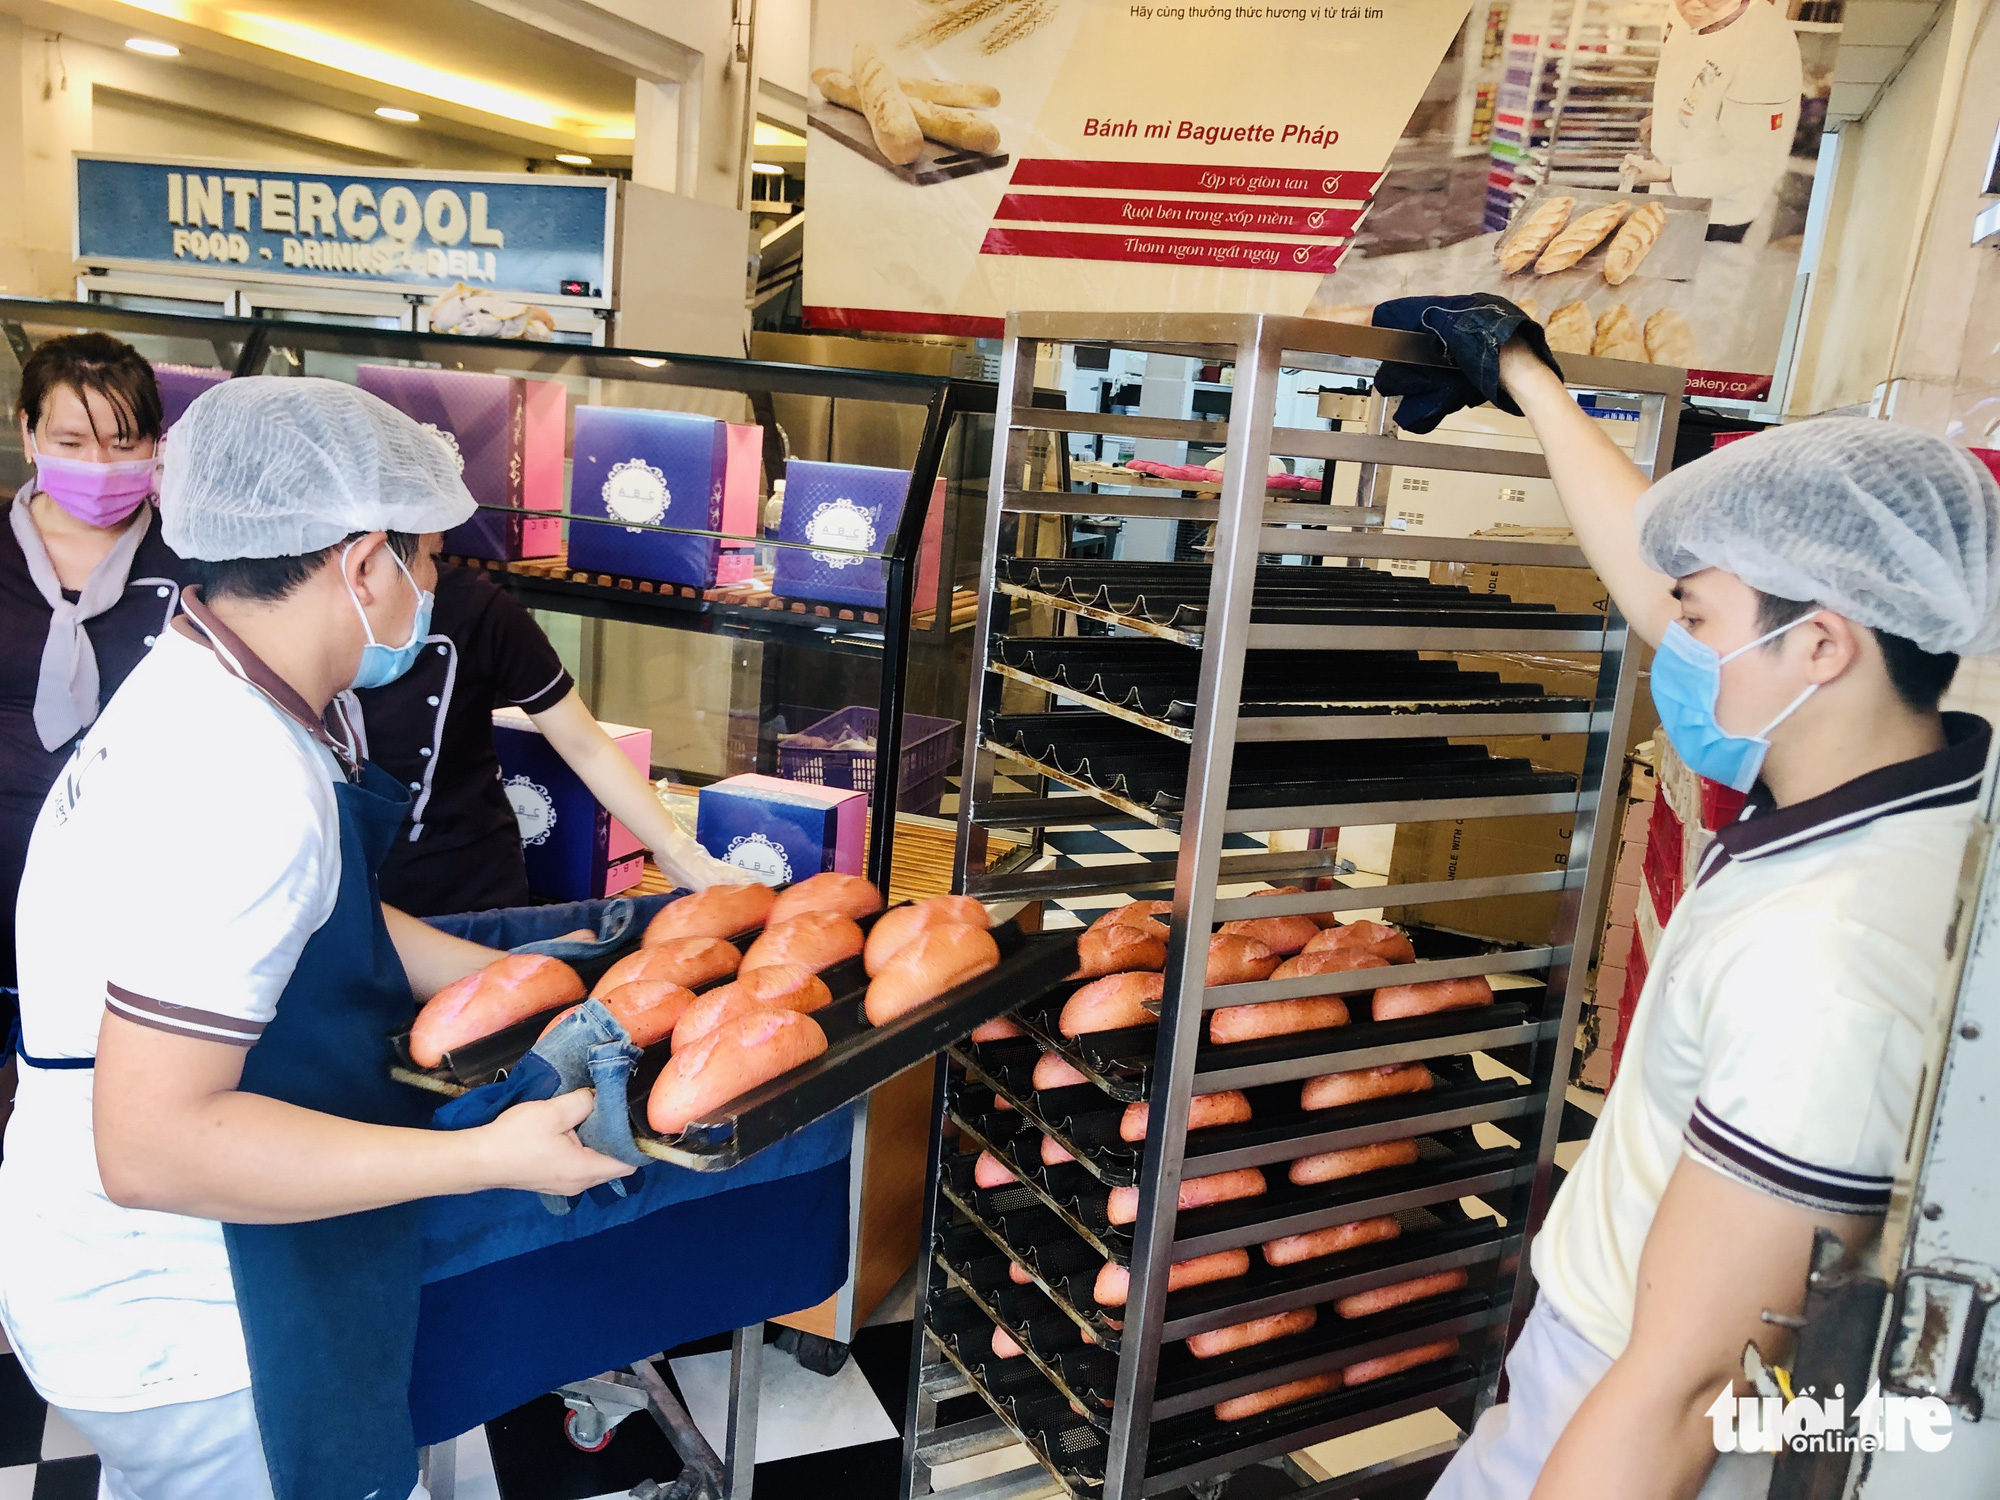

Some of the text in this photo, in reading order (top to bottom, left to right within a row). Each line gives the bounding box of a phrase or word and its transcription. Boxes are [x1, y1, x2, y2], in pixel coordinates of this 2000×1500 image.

[1130, 5, 1153, 20] Hãy
[1156, 6, 1185, 20] cùng
[1188, 6, 1232, 21] thưởng
[1235, 6, 1262, 19] thức
[1266, 7, 1306, 21] hương
[1310, 7, 1320, 20] vị
[1341, 7, 1361, 19] trái
[1364, 7, 1383, 19] tim
[1083, 118, 1339, 149] Bánh mì Baguette Pháp
[1247, 175, 1281, 192] giòn
[1284, 177, 1309, 190] tan
[168, 173, 503, 248] INTERCOOL
[1121, 202, 1154, 220] Ruột
[1156, 204, 1182, 219] bên
[1185, 208, 1224, 227] trong
[173, 229, 250, 264] FOOD
[283, 237, 394, 275] DRINKS
[427, 247, 496, 283] DELI
[1124, 238, 1281, 265] Thơm ngon ngất ngây
[1487, 570, 1499, 594] NDLE
[1452, 828, 1463, 850] WITH
[1447, 854, 1458, 881] NDLE
